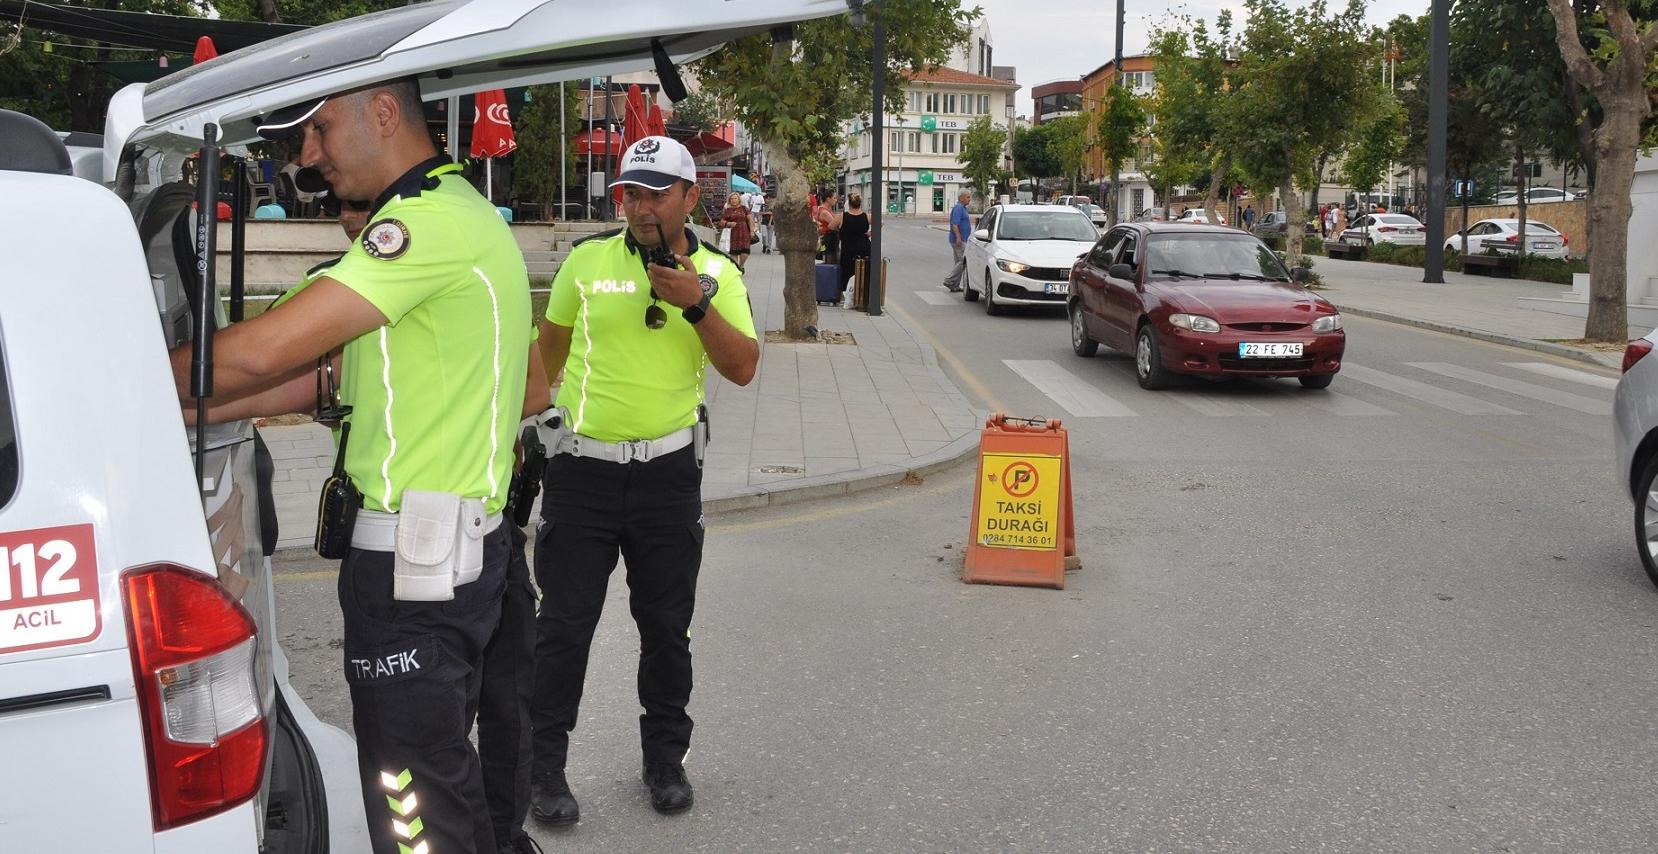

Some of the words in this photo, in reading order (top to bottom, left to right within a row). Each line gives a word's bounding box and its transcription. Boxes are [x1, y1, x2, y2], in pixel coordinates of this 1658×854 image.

[1246, 344, 1259, 355] 22
[1264, 344, 1277, 355] FE
[1282, 344, 1301, 355] 745
[996, 500, 1042, 515] TAKSİ
[987, 517, 1048, 533] DURAĞI
[1008, 534, 1024, 544] 714
[1027, 536, 1038, 544] 36
[1040, 536, 1051, 545] 01
